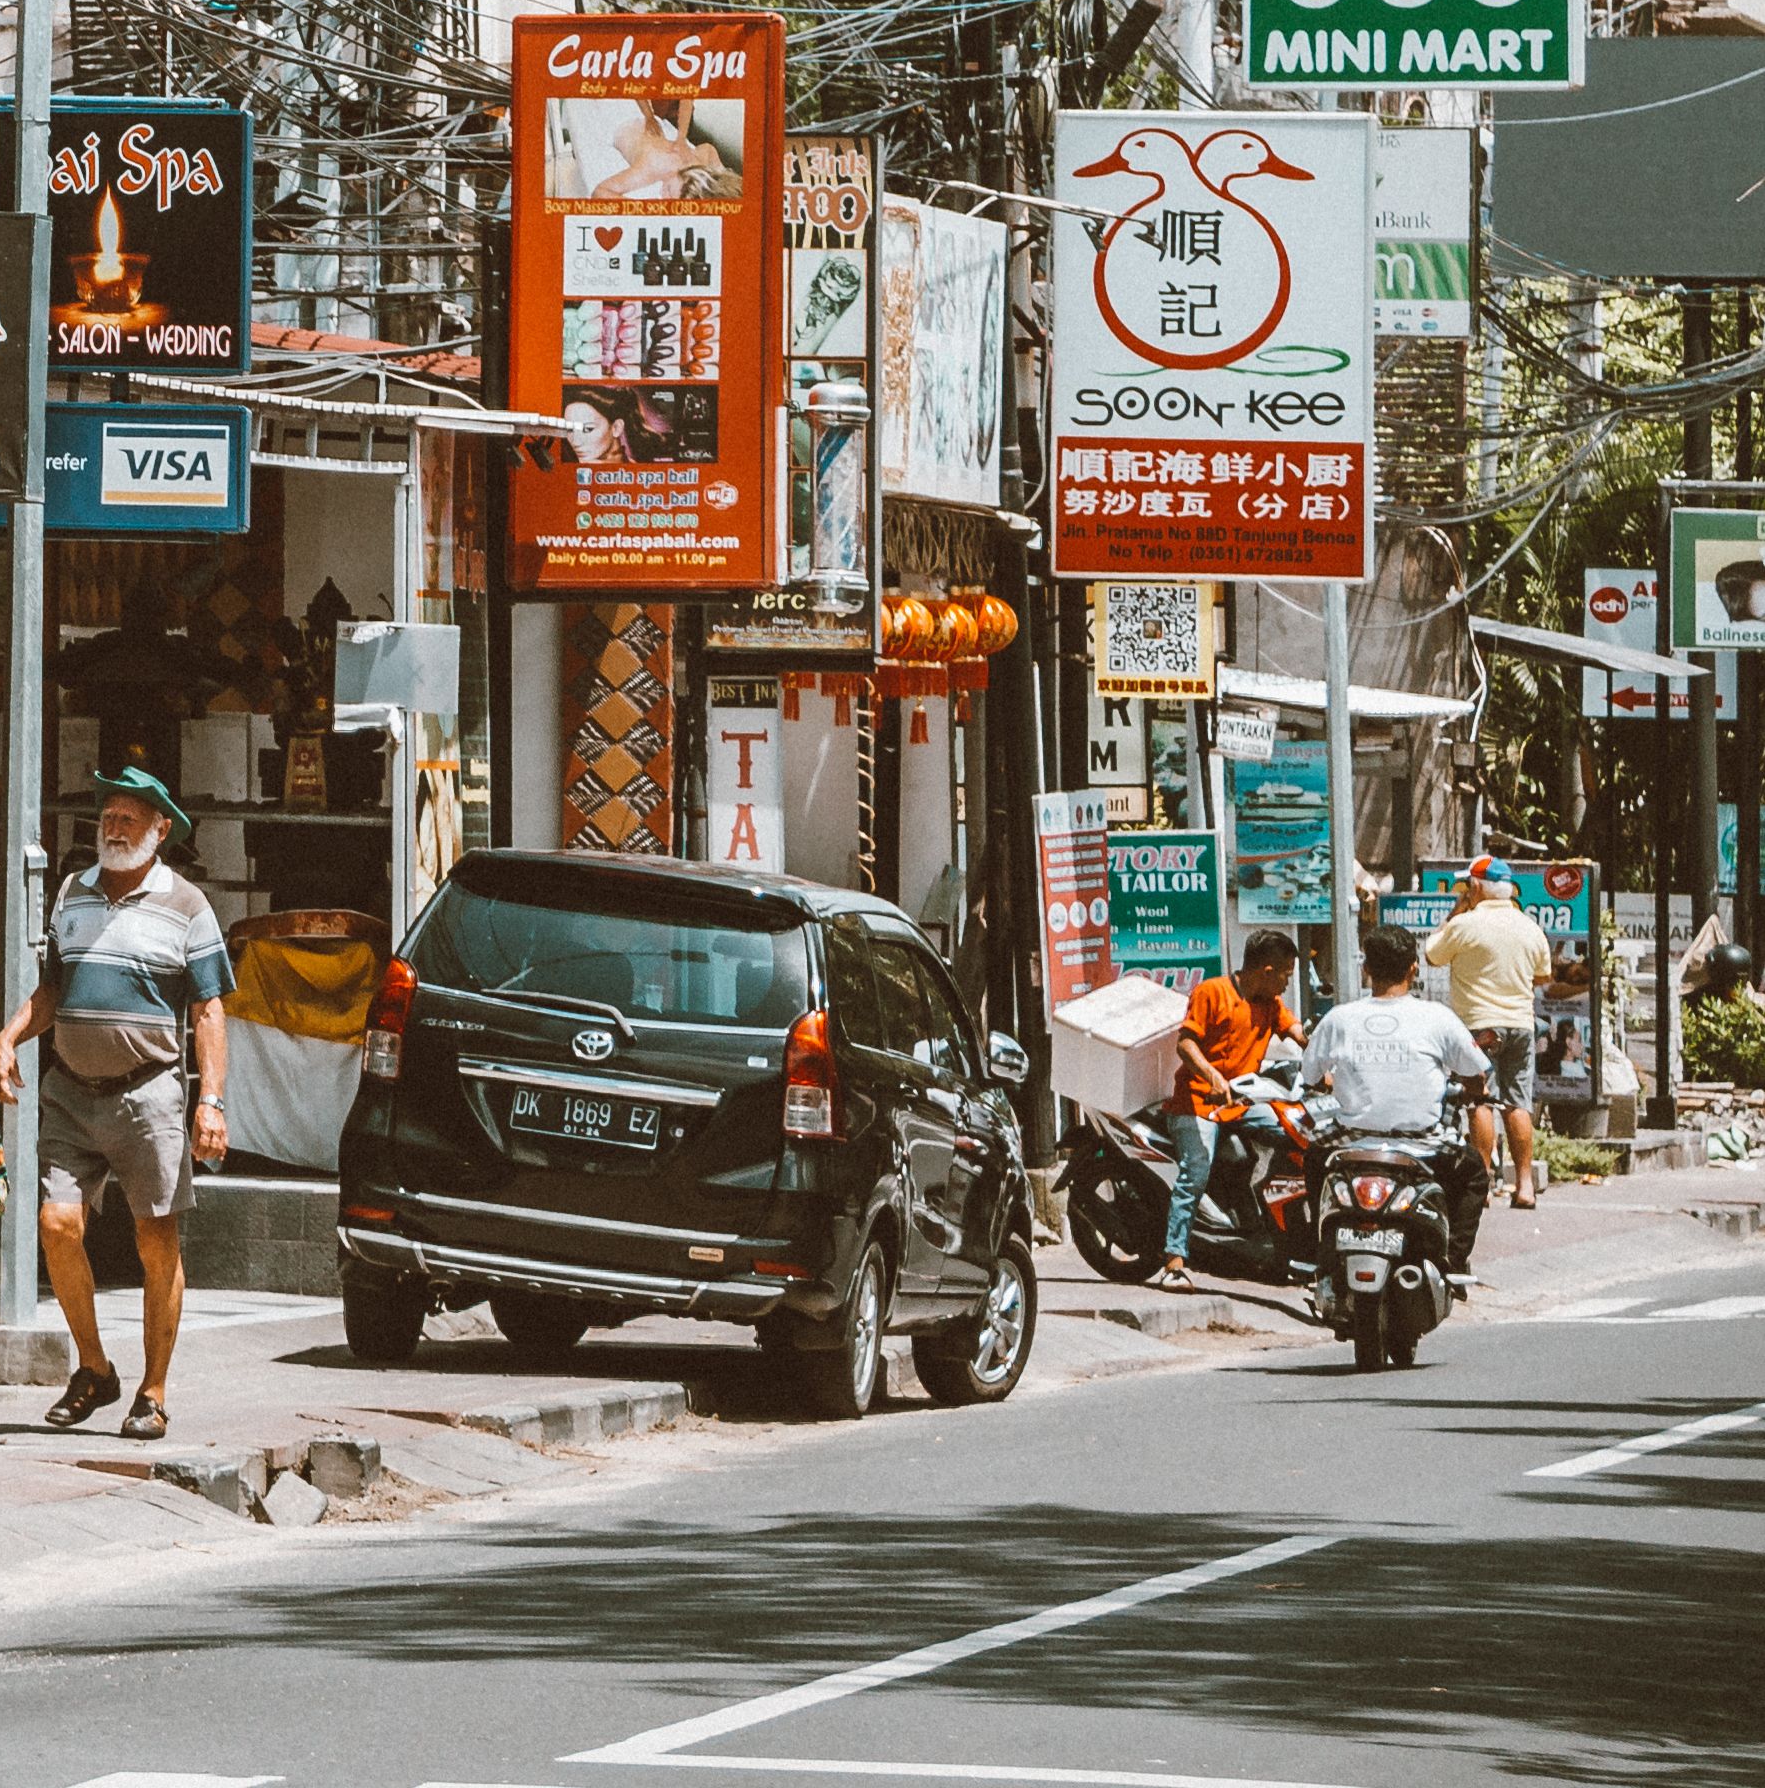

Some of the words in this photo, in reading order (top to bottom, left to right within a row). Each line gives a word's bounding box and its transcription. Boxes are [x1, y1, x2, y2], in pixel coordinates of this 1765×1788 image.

[1264, 29, 1386, 73] MINI
[1399, 29, 1552, 73] MART
[548, 35, 653, 78] Carla
[667, 36, 746, 88] Spa
[580, 82, 606, 96] Body
[623, 82, 646, 94] Hair
[663, 83, 700, 96] Beauty
[48, 132, 100, 196] ai
[117, 123, 223, 211] Spa
[574, 201, 619, 214] Massage
[1375, 212, 1431, 229] Bank
[1158, 209, 1223, 338] 順記
[59, 322, 121, 355] SALON
[146, 324, 231, 358] WEDDING
[120, 449, 212, 481] VISA
[595, 469, 633, 483] carla
[637, 471, 664, 487] spa
[668, 469, 698, 484] bali
[537, 534, 739, 551] www.carlaspabali.com
[1096, 524, 1163, 540] Pratama
[1168, 526, 1191, 540] No
[1233, 528, 1298, 546] Tanjung
[1302, 529, 1356, 544] Benoa
[548, 553, 575, 565] Daily
[579, 553, 608, 565] Open
[612, 553, 643, 564] 09.00
[646, 556, 664, 564] am
[675, 553, 706, 564] 11.00
[708, 556, 726, 566] pm
[1108, 544, 1132, 558] No
[1139, 544, 1172, 561] Telp
[711, 682, 747, 702] BEST
[1107, 846, 1207, 872] TORY
[1117, 873, 1208, 893] TAILOR
[1135, 905, 1169, 917] Wool
[1383, 908, 1427, 925] MONEY
[1524, 904, 1572, 931] spa
[1136, 923, 1173, 934] Linen
[515, 1090, 541, 1117] DK
[563, 1098, 611, 1127] 1869
[629, 1107, 655, 1134] EZ
